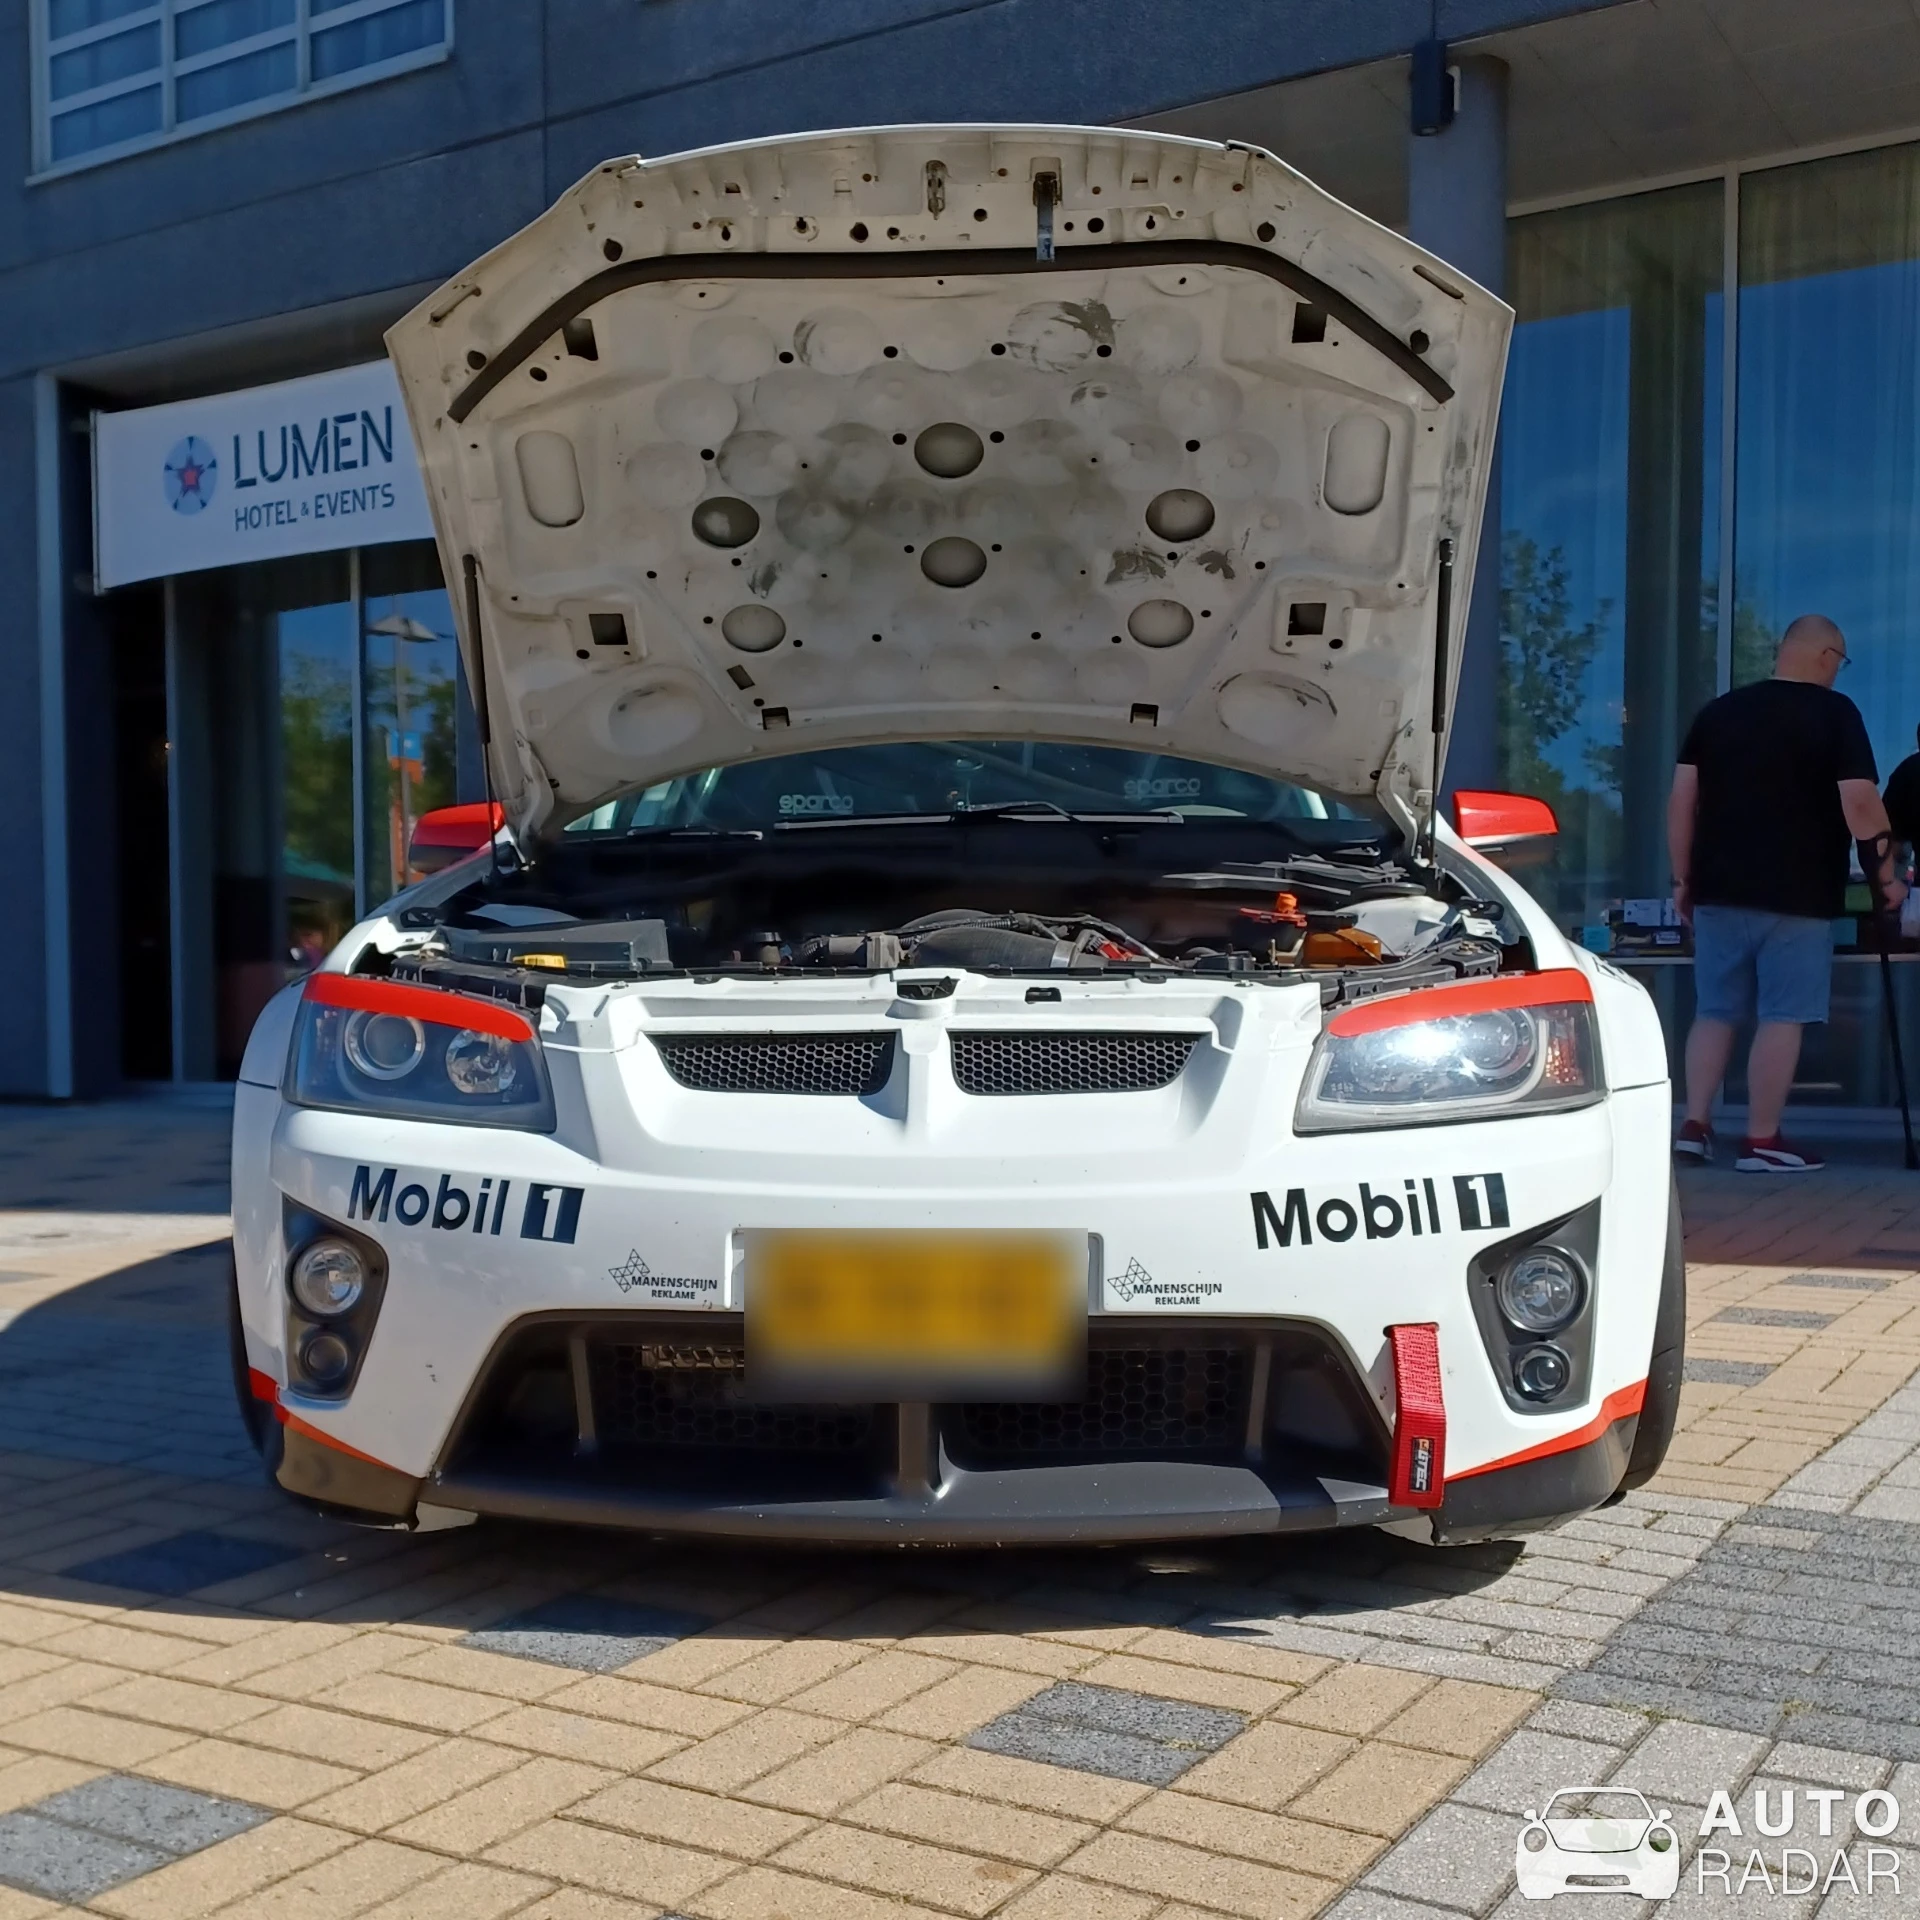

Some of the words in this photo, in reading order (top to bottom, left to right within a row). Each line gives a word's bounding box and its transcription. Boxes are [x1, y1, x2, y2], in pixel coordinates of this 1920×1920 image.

[233, 405, 393, 489] LUMEN
[234, 499, 298, 532] HOTEL
[300, 501, 310, 518] &
[314, 483, 396, 520] EVENTS
[1124, 779, 1200, 799] sparco
[779, 795, 854, 815] sparco
[347, 1165, 511, 1236] Mobil
[1250, 1177, 1442, 1250] Mobil
[631, 1276, 718, 1292] MANENSCHIJN
[1133, 1283, 1223, 1296] MANENSCHIJN
[651, 1289, 696, 1300] REKLAME
[1155, 1296, 1201, 1305] REKLAME
